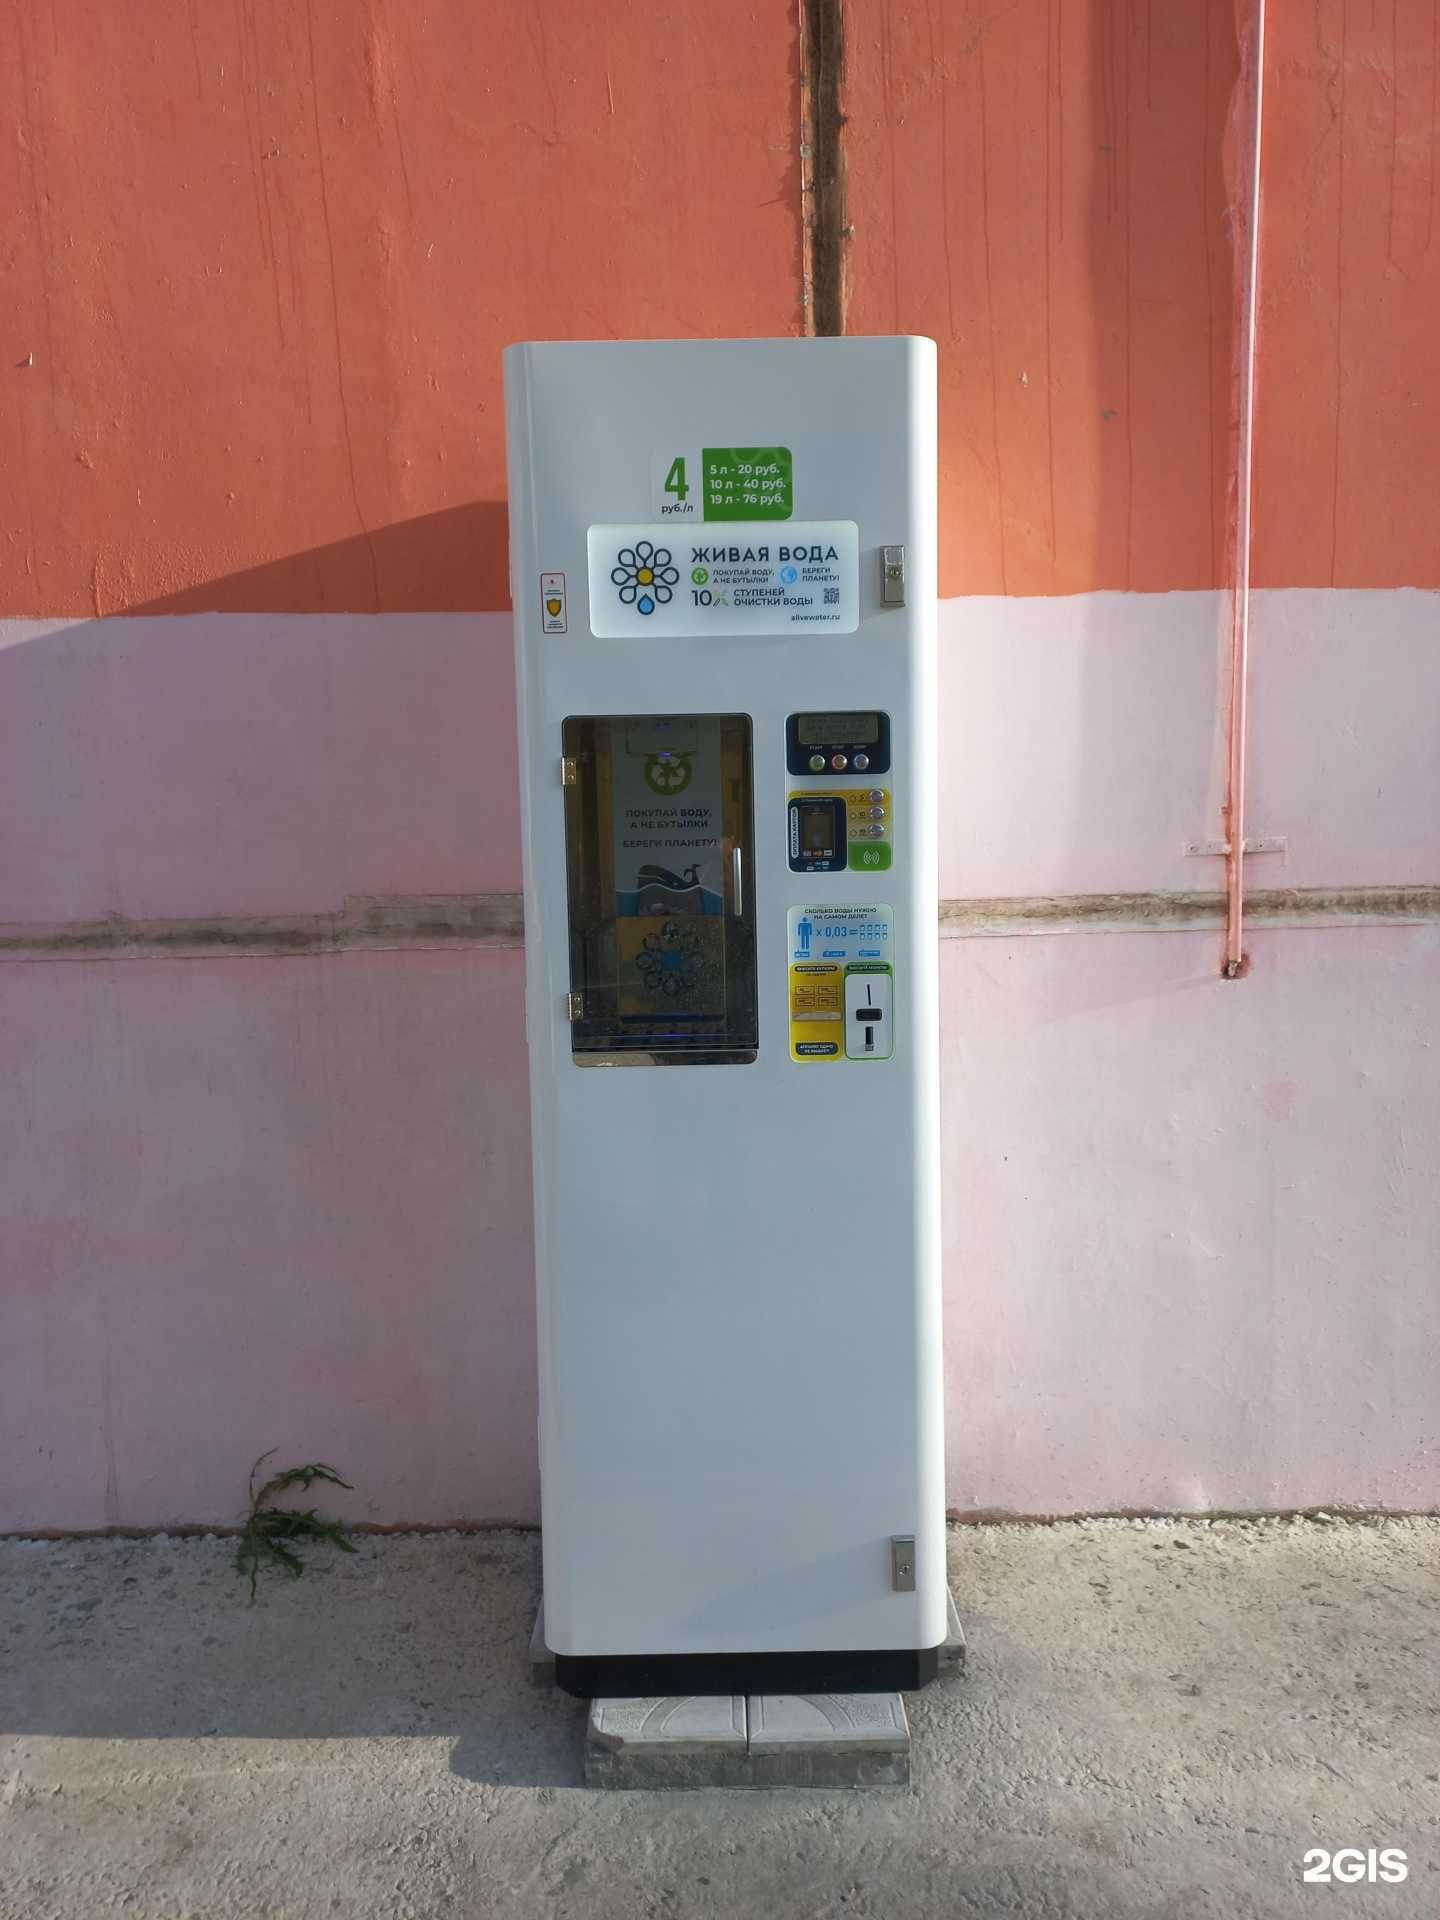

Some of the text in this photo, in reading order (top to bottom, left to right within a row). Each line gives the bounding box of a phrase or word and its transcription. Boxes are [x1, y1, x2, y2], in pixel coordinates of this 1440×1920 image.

[710, 465, 717, 474] 5
[720, 466, 728, 474] л
[738, 464, 752, 474] 20
[755, 463, 780, 476] руб.
[664, 457, 690, 501] 4
[711, 479, 722, 489] 10
[725, 481, 733, 489] л
[744, 479, 759, 489] 40
[762, 477, 786, 490] руб.
[711, 494, 722, 504] 19
[725, 496, 733, 504] л
[743, 494, 759, 504] 76
[760, 493, 785, 505] руб.
[661, 503, 694, 514] руб./л
[691, 546, 839, 563] ЖИВАЯ ВОДА
[713, 568, 775, 577] ПОКУПАЙ ВОДУ,
[734, 587, 785, 597] СТУПЕНЕЙ
[734, 597, 813, 606] ОЧИСТКИ ВОДЫ
[625, 808, 712, 818] ПОКУПАЙ ВОДУ,
[630, 820, 708, 829] А НЕ БУТЫЛКИ
[623, 840, 661, 848] БЕРЕГИ
[825, 926, 847, 938] 0,03
